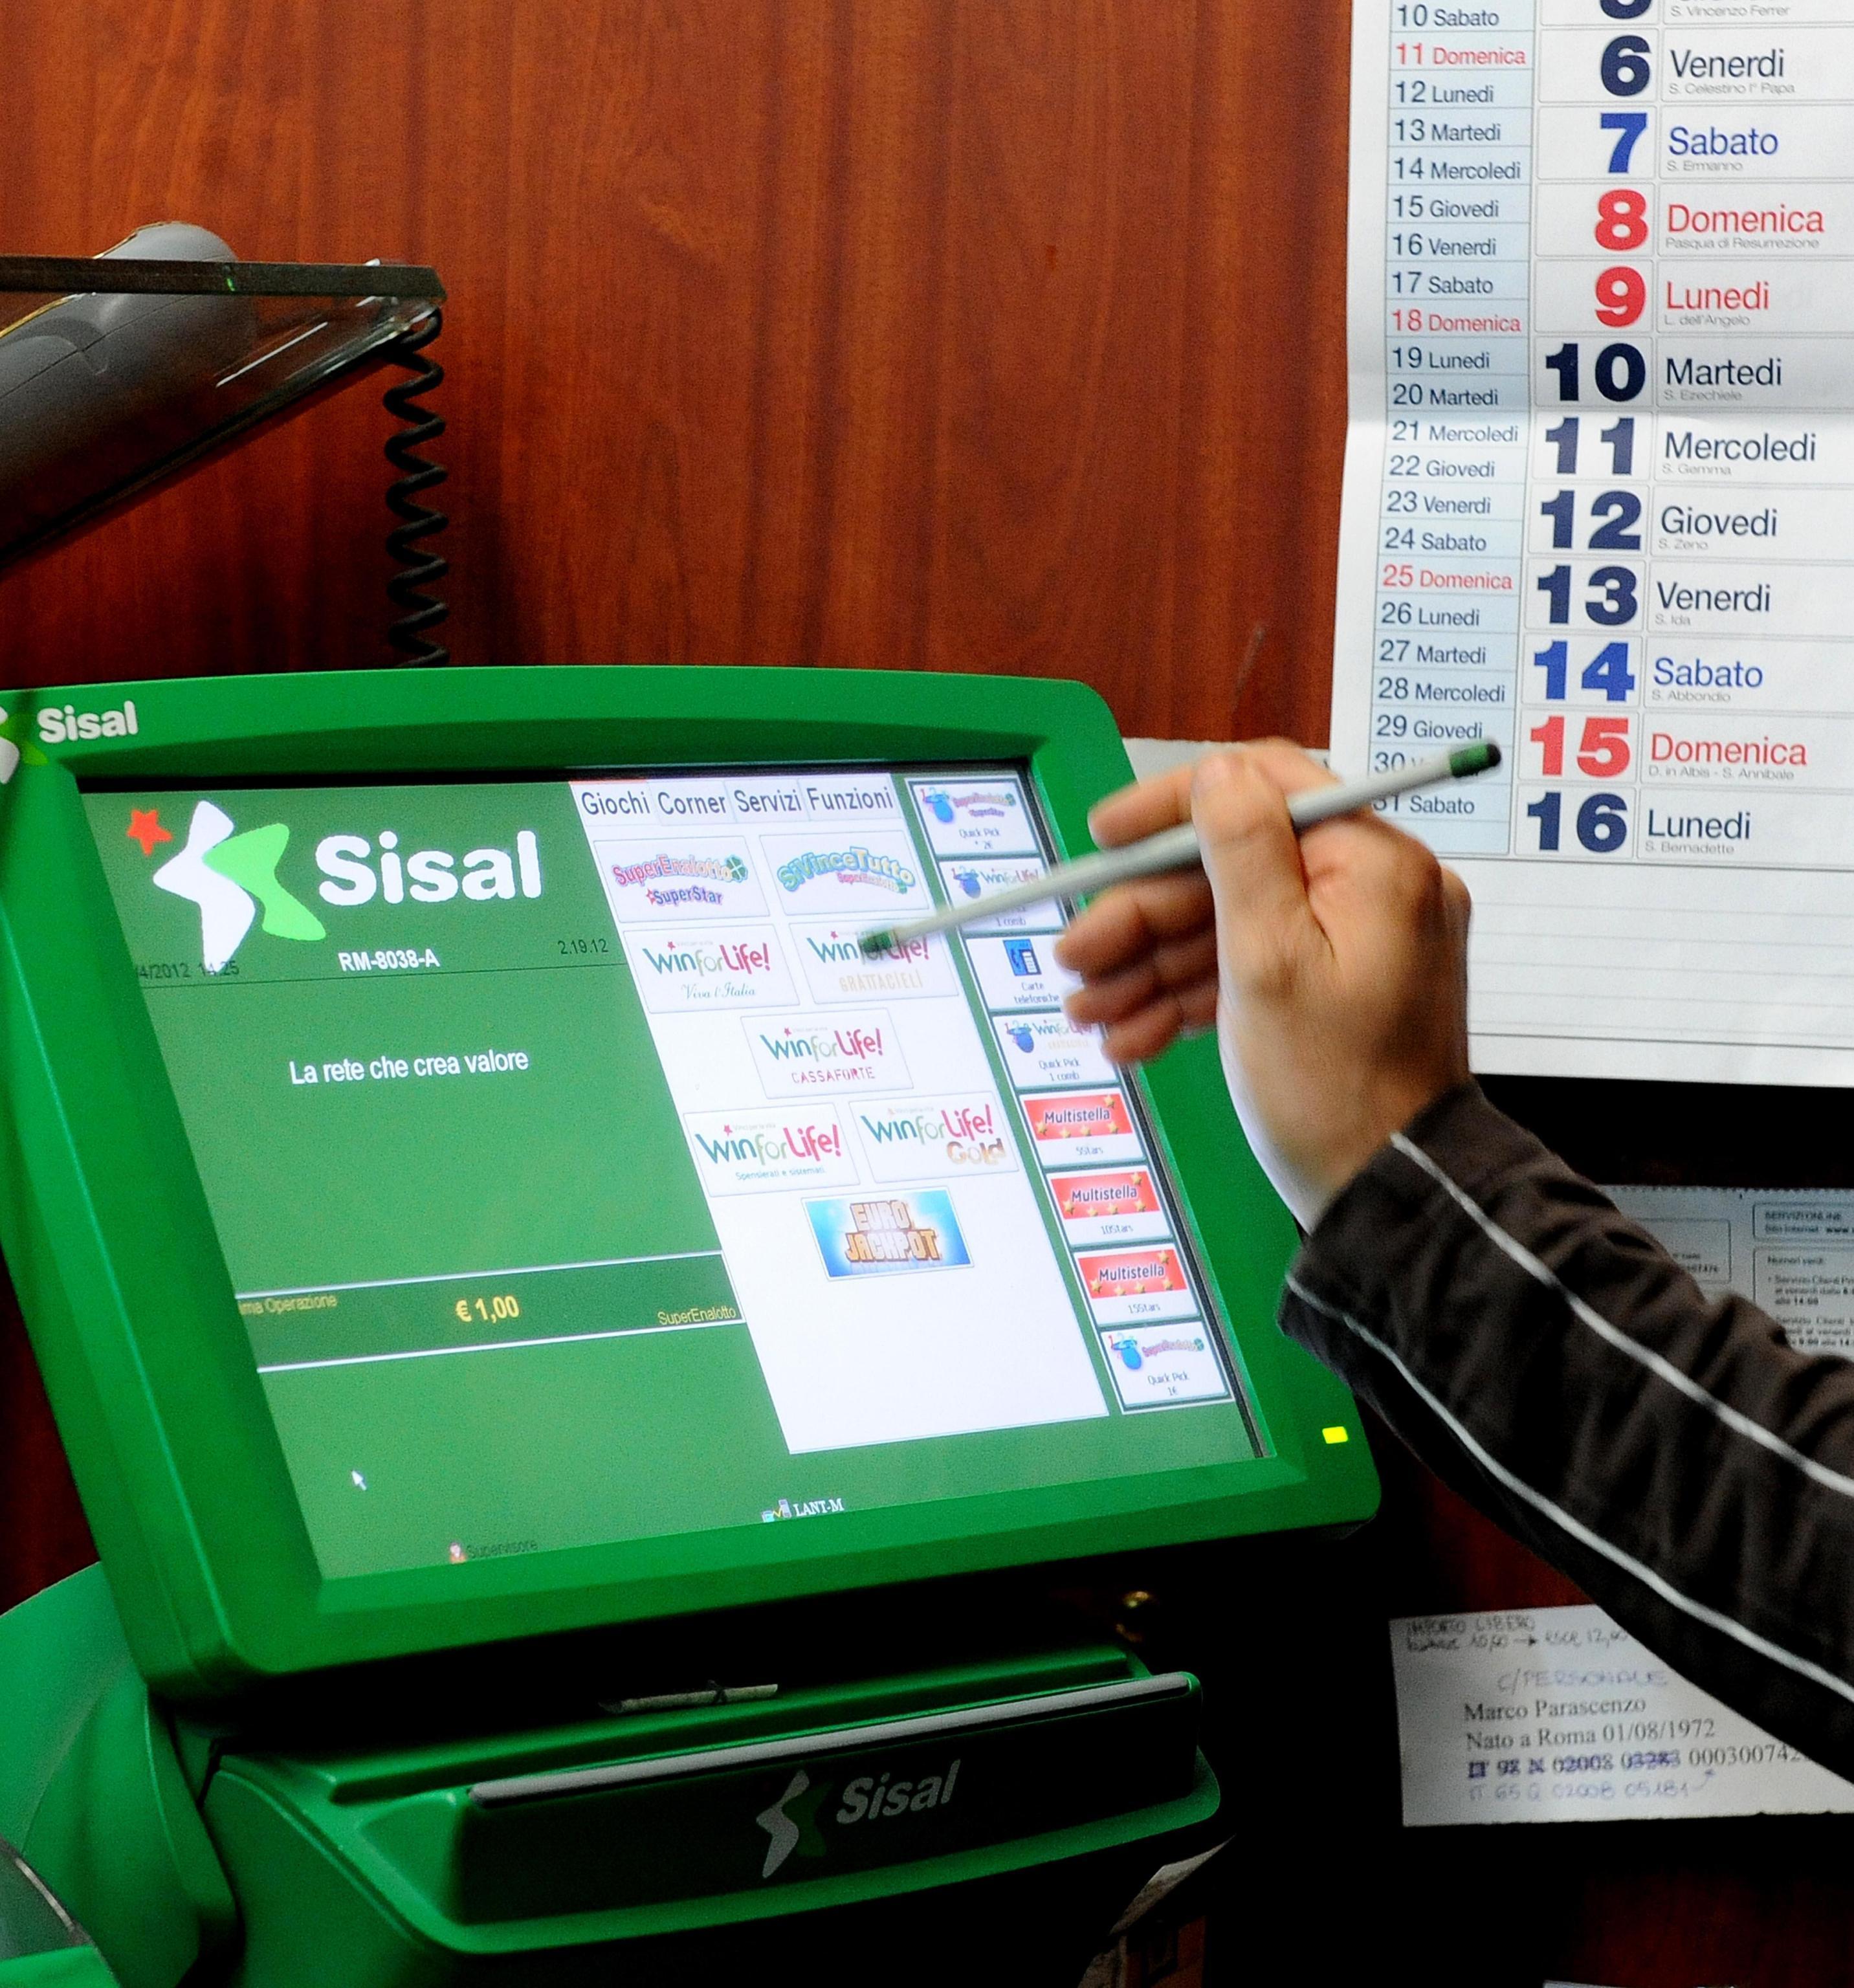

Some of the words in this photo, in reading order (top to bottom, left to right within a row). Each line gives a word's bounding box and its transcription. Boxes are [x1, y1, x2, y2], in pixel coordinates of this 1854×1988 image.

[1396, 5, 1428, 27] 10
[1433, 8, 1499, 26] Sabato
[1671, 6, 1682, 16] S.
[1686, 5, 1747, 17] Vincenzo
[1750, 6, 1790, 16] Ferrer
[1396, 43, 1424, 65] 11
[1433, 47, 1526, 65] Domenica
[1600, 35, 1651, 96] 6
[1671, 49, 1784, 78] Venerdi
[1395, 82, 1426, 103] 12
[1432, 85, 1494, 103] Lunedi
[1685, 83, 1746, 94] Celestino
[1760, 84, 1795, 96] Papa
[1395, 119, 1426, 141] 13
[1431, 123, 1500, 141] Martedi
[1600, 113, 1648, 173] 7
[1668, 127, 1778, 157] Sabato
[1394, 157, 1424, 179] 14
[1431, 162, 1521, 180] Mercoledi
[1682, 160, 1743, 171] Ermanno
[1393, 196, 1423, 217] 15
[1429, 199, 1499, 218] Giovedi
[1595, 189, 1648, 250] 8
[1666, 204, 1824, 234] Domenica
[1393, 234, 1422, 255] 16
[1429, 238, 1495, 256] Venerdi
[1666, 237, 1715, 250] Pasqua
[1719, 237, 1729, 248] di
[1732, 237, 1819, 249] Resurrezione
[1392, 272, 1421, 293] 17
[1429, 276, 1493, 294] Sabato
[1595, 265, 1646, 327] 9
[1666, 282, 1769, 310] Lunedi
[1392, 309, 1421, 331] 18
[1428, 314, 1521, 332] Domenica
[1677, 313, 1750, 327] dell'Angelo
[1392, 347, 1421, 368] 19
[1429, 351, 1489, 369] Lunedi
[1545, 343, 1646, 401] 10
[1666, 358, 1782, 386] Martedi
[1393, 384, 1422, 404] 20
[1429, 388, 1498, 406] Martedi
[1682, 390, 1742, 401] Ezechiele
[1392, 421, 1420, 441] 21
[1428, 425, 1518, 443] Mercoledi
[1545, 417, 1635, 475] 11
[1666, 432, 1816, 462] Mercoledi
[1389, 456, 1420, 476] 22
[1426, 459, 1495, 479] Giovedi
[1678, 465, 1731, 476] Gemma
[1387, 492, 1417, 513] 23
[1424, 495, 1491, 514] Venerdi
[1540, 490, 1642, 550] 12
[1661, 506, 1777, 537] Giovedi
[1384, 529, 1416, 549] 24
[1421, 532, 1486, 551] Sabato
[1673, 540, 1708, 550] Zeno
[1382, 566, 1413, 588] 25
[1420, 569, 1512, 590] Domenica
[1537, 565, 1638, 625] 13
[1656, 581, 1771, 612] Venerdi
[1382, 603, 1412, 624] 26
[1418, 607, 1480, 626] Lunedi
[1670, 615, 1690, 625] Ida
[1380, 641, 1410, 662] 27
[1417, 645, 1486, 664] Martedi
[1533, 641, 1635, 701] 14
[1653, 657, 1763, 688] Sabato
[1378, 678, 1409, 700] 28
[1415, 682, 1505, 703] Mercoledi
[1668, 690, 1730, 702] Abbondio
[37, 700, 138, 744] Sisal
[1376, 715, 1407, 737] 29
[1413, 719, 1483, 740] Giovedi
[1530, 716, 1631, 777] 15
[1651, 734, 1807, 765] Domenica
[1374, 752, 1406, 774] 30
[1679, 767, 1709, 777] Albis
[1738, 768, 1794, 780] Annibale
[582, 791, 650, 815] Giochi
[658, 791, 726, 815] Corner
[734, 790, 802, 813] Servizi
[807, 788, 893, 810] Funzioni
[1409, 795, 1475, 814] Sabato
[959, 828, 980, 838] Quick
[1527, 792, 1628, 853] 16
[1648, 809, 1750, 839] Lunedi
[1661, 843, 1734, 855] Bernadette
[315, 830, 542, 906] Sisal
[612, 854, 733, 887] SuperEnalotto
[777, 846, 916, 892] SiVinceTutto
[654, 885, 723, 905] SuperStar
[558, 938, 608, 955] 2.19.12
[338, 949, 440, 971] RM-8038-A
[681, 984, 711, 1000] Viva
[839, 969, 923, 993] GRATTACIELI
[1021, 982, 1044, 991] Carte
[289, 1061, 318, 1085] La
[323, 1058, 364, 1083] rete
[370, 1055, 409, 1079] che
[414, 1056, 460, 1077] crea
[465, 1049, 529, 1074] valore
[791, 1066, 876, 1085] CASSAFORTE
[1039, 1060, 1060, 1069] Quick
[1063, 1059, 1081, 1067] Pick
[1044, 1107, 1110, 1125] Multistella
[947, 1138, 1006, 1165] Gold
[735, 1167, 779, 1180] Spensierati
[1072, 1186, 1137, 1202] Multistella
[850, 1200, 916, 1231] EURO
[1101, 1224, 1133, 1235] 10Stars
[845, 1229, 940, 1263] JACKPOT
[1099, 1264, 1165, 1281] Multistella
[265, 1295, 338, 1314] Operazione
[456, 1300, 472, 1323] €
[475, 1296, 519, 1324] 1,00
[657, 1306, 736, 1325] SuperEnalotto
[1128, 1303, 1161, 1314] 15Stars
[1148, 1374, 1169, 1386] Quick
[1172, 1372, 1189, 1382] Pick
[793, 1498, 844, 1517] LANT-M
[1464, 1701, 1528, 1723] Marco
[1535, 1697, 1647, 1718] Parascenzo
[1466, 1729, 1514, 1751] Nato
[1520, 1734, 1530, 1747] a
[1538, 1727, 1596, 1746] Roma
[1603, 1718, 1716, 1742] 01/08/1972
[836, 1758, 960, 1825] Sisal
